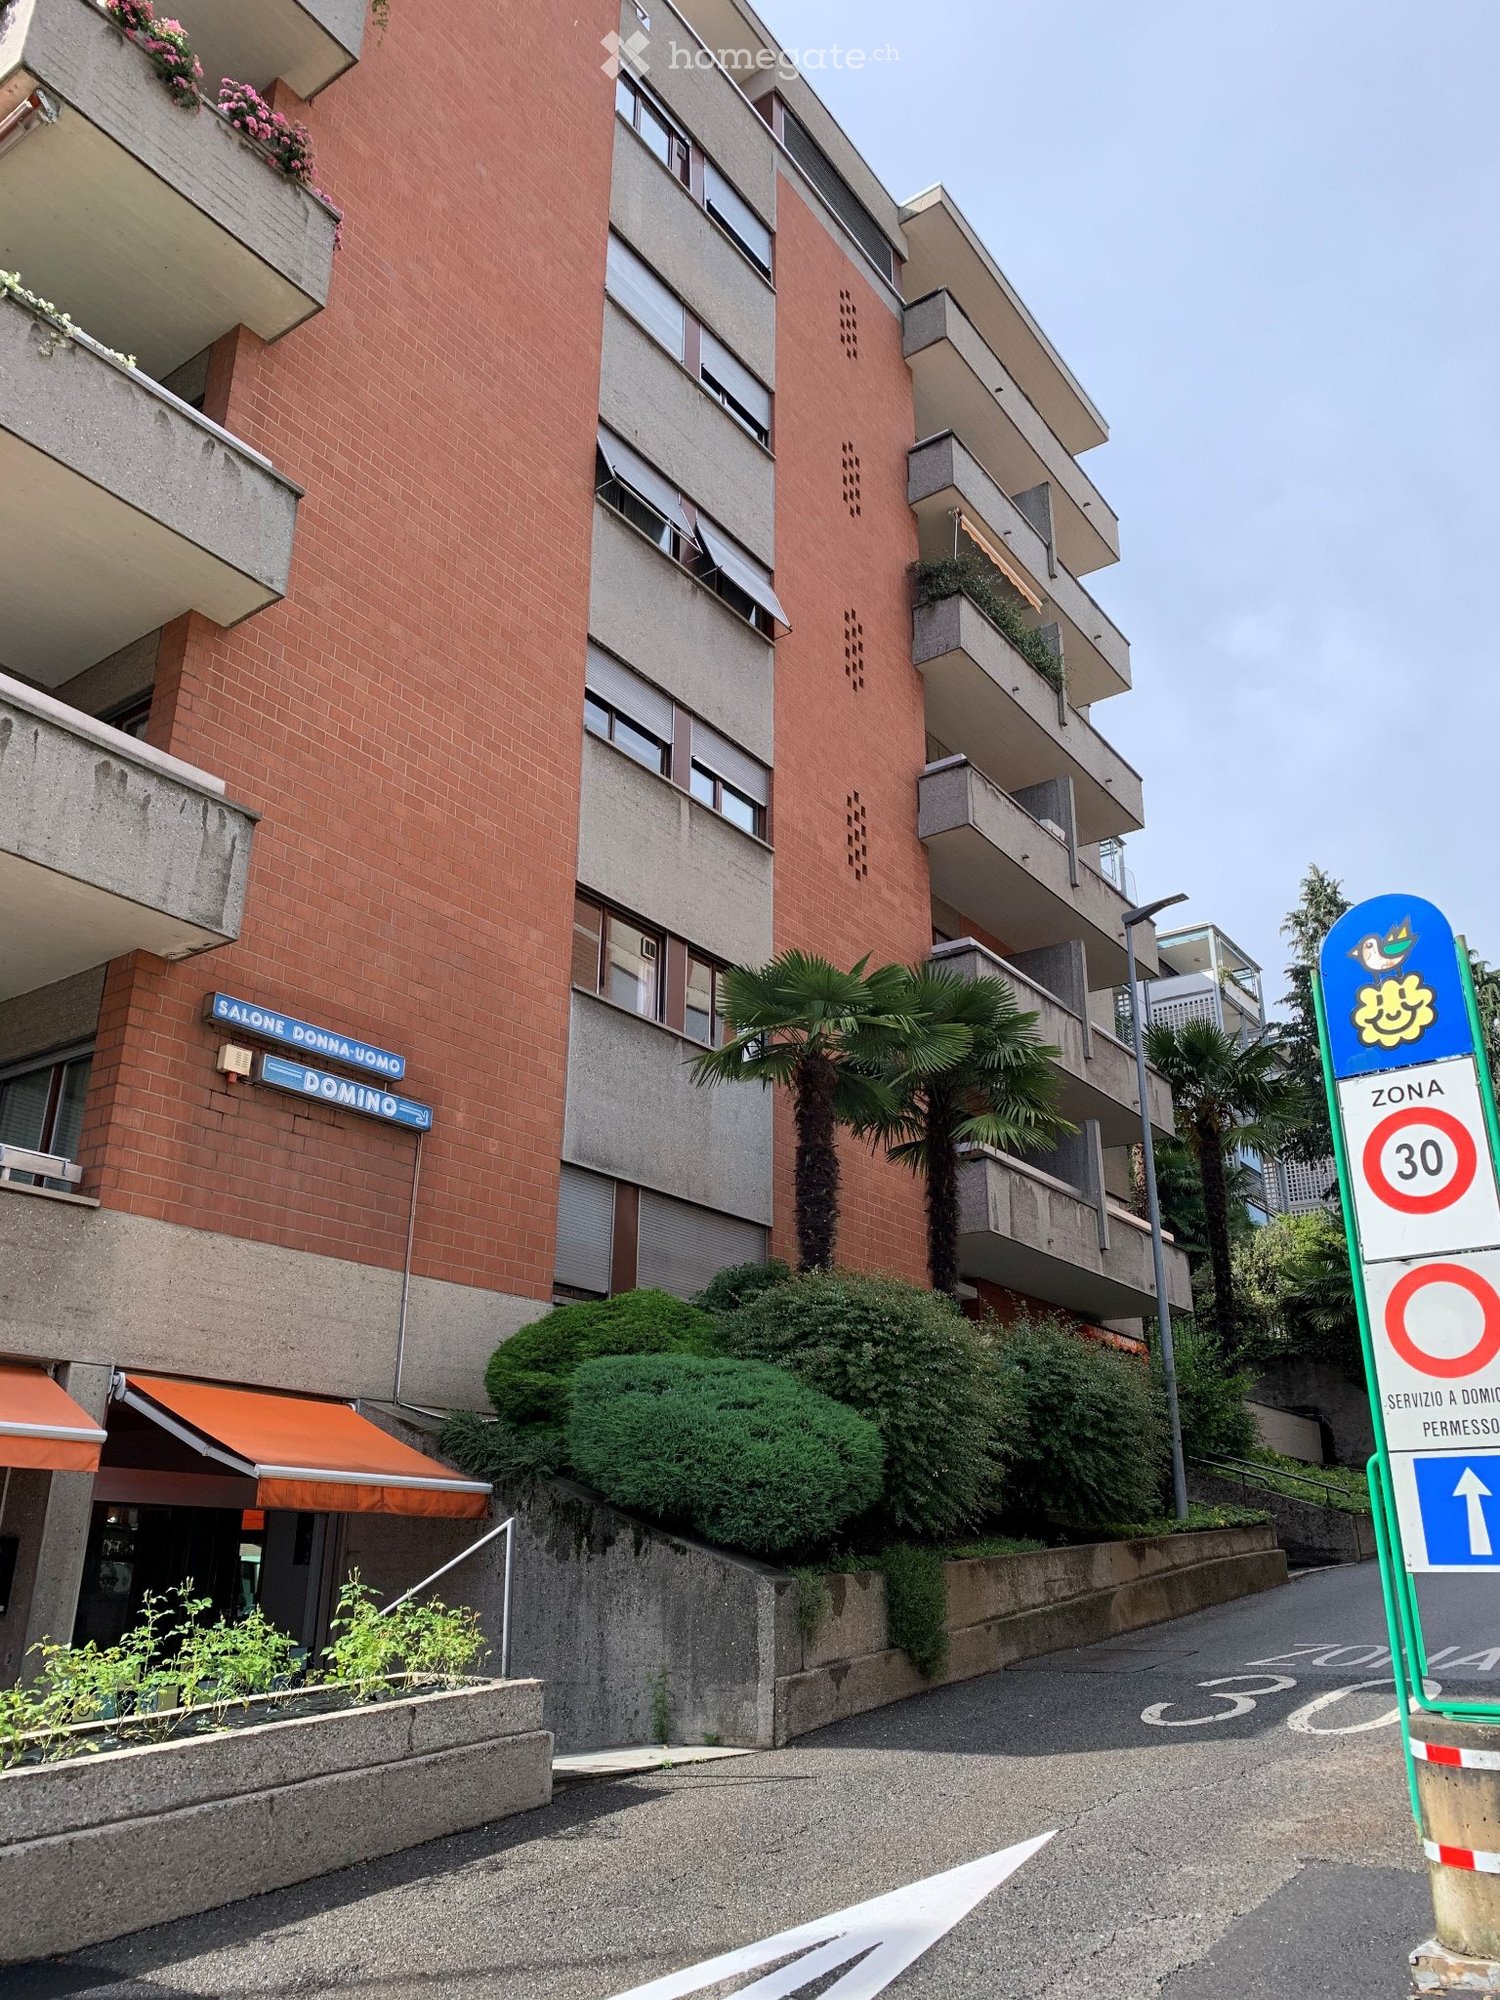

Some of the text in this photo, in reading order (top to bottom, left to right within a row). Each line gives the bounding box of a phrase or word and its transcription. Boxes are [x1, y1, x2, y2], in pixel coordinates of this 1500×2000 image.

[217, 999, 285, 1035] SALONE
[303, 1071, 398, 1118] DOMINO
[1371, 1079, 1445, 1107] ZONA
[1395, 1139, 1443, 1181] 30
[1387, 1390, 1444, 1410] SERVIZIO
[1449, 1390, 1457, 1406] A
[1422, 1417, 1500, 1437] PERMESSO
